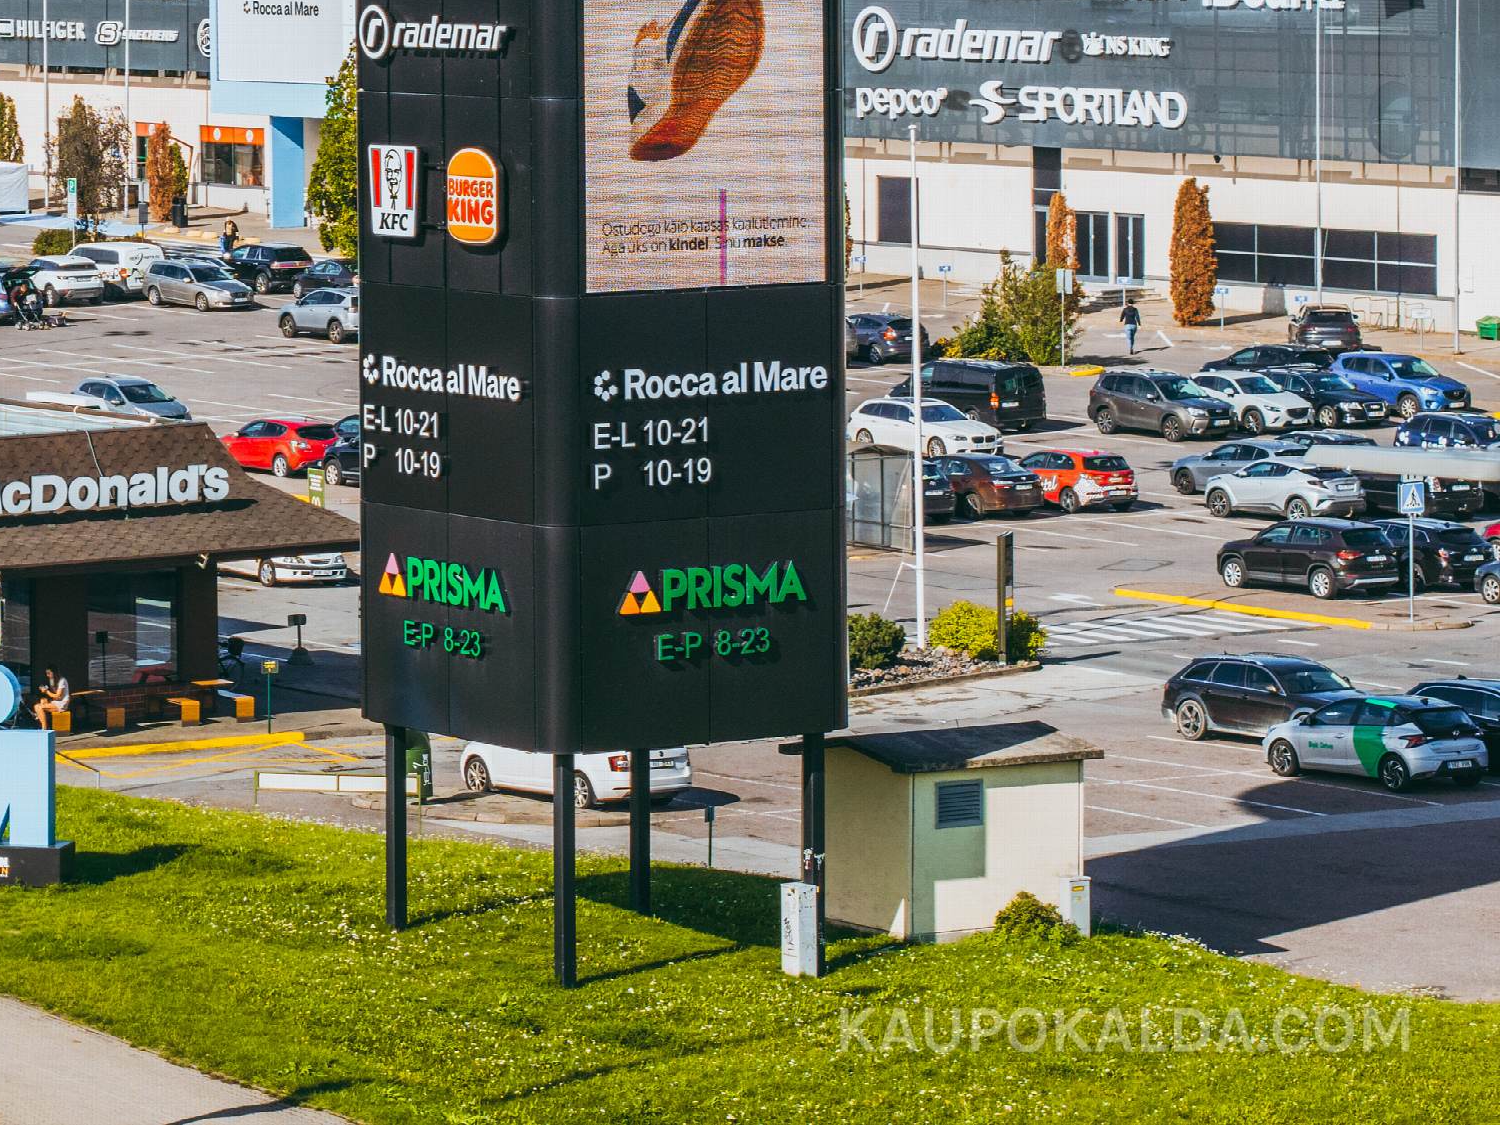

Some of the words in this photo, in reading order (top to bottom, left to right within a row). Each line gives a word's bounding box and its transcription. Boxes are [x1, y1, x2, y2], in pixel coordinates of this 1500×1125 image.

[253, 0, 283, 16] Rocca
[284, 1, 293, 16] al
[295, 1, 320, 17] Mare
[16, 19, 86, 40] HILFIGER
[392, 15, 507, 51] rademar
[900, 19, 1061, 61] rademar
[1128, 37, 1170, 57] KING
[855, 87, 941, 118] pepco
[1018, 85, 1188, 129] SPORTLAND
[448, 178, 494, 198] BURGER
[379, 212, 409, 231] KFC
[448, 199, 494, 225] KING
[651, 240, 667, 252] on
[381, 356, 444, 394] Rocca
[446, 364, 465, 395] al
[467, 365, 521, 402] Mare
[624, 368, 717, 400] Rocca
[721, 361, 748, 395] al
[754, 360, 828, 392] Mare
[364, 404, 391, 432] E-L
[394, 408, 440, 439] 10-21
[593, 421, 636, 450] E-L
[643, 417, 709, 447] 10-21
[364, 443, 376, 468] P
[394, 447, 441, 478] 10-19
[593, 463, 612, 490] P
[643, 457, 712, 487] 10-19
[406, 556, 507, 614] PRISMA
[661, 560, 807, 613] PRISMA
[403, 619, 435, 649] E-P
[443, 628, 482, 658] 8-23
[656, 632, 702, 663] E-P
[716, 627, 771, 658] 8-23
